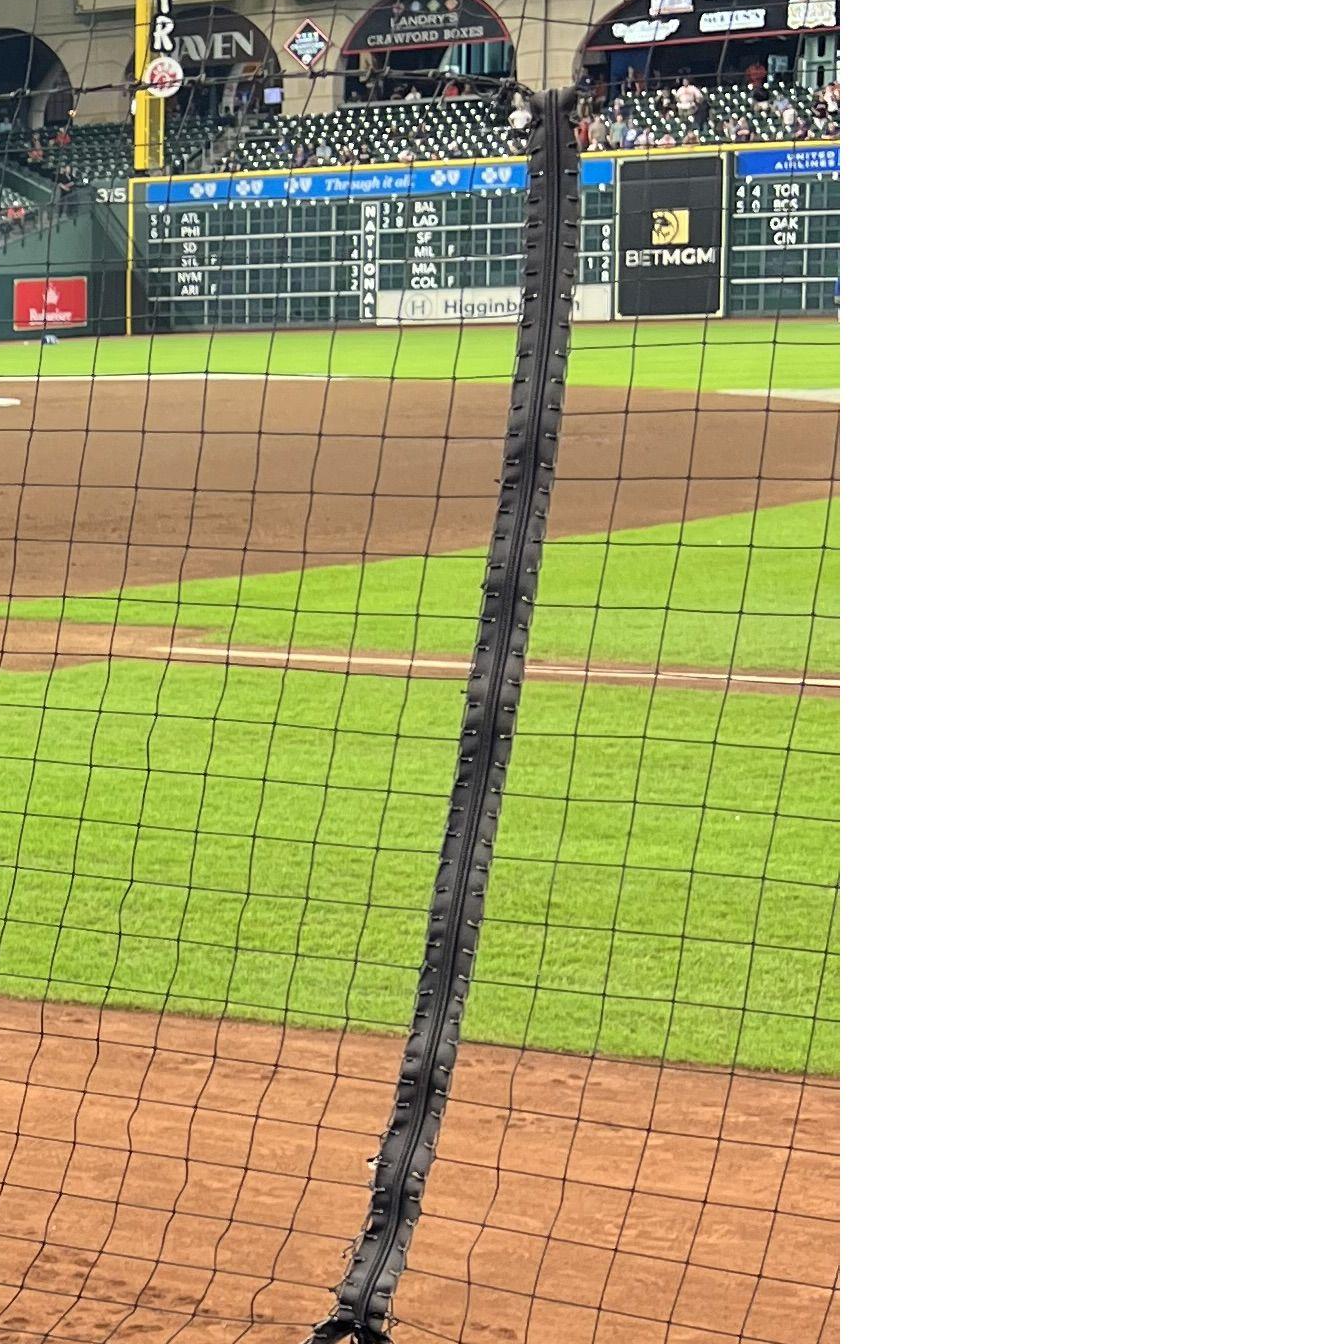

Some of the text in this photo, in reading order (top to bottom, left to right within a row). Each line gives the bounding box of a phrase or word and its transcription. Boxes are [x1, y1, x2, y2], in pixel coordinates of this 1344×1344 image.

[390, 12, 459, 29] LANDRY'S
[367, 26, 484, 47] CRAWFORD BOXES
[172, 29, 255, 62] AVEN
[786, 151, 836, 161] UNITED
[774, 159, 836, 170] AIRLINES
[325, 177, 380, 192] Through
[736, 183, 800, 198] 4 4 TOR
[96, 187, 127, 204] 315
[382, 201, 436, 215] 3 7 BAL
[180, 212, 200, 225] ATL
[382, 216, 390, 229] 2
[412, 215, 439, 227] LAD
[769, 216, 799, 231] OAK
[416, 231, 432, 244] SF
[773, 231, 797, 246] CIN
[414, 245, 435, 258] MIL
[625, 246, 717, 267] BETMGM
[363, 205, 377, 318] NATIONAL
[412, 262, 437, 275] MIA
[410, 276, 439, 290] COL
